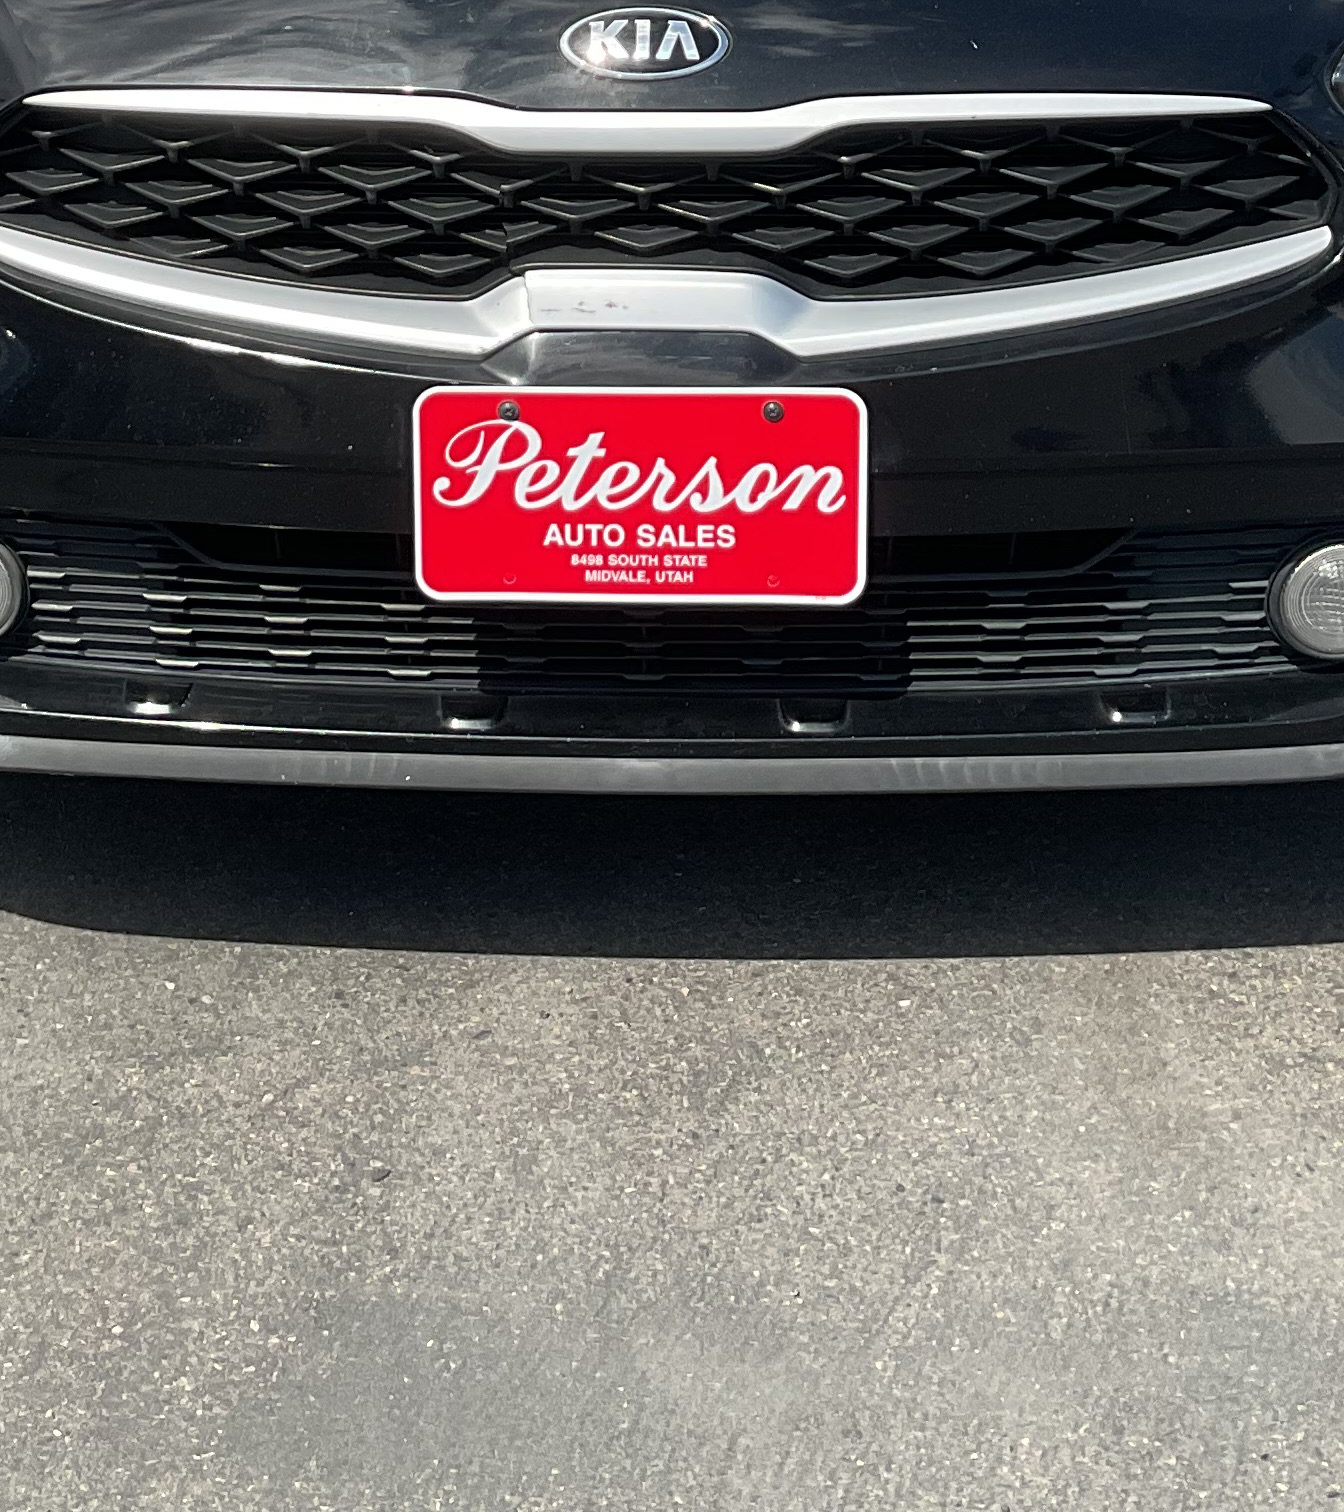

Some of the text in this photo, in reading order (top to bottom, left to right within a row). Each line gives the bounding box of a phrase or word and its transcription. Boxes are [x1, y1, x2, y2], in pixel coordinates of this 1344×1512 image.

[589, 19, 700, 62] KIA
[432, 419, 847, 514] Peterson
[543, 523, 737, 549] AUTO SALES
[571, 553, 708, 567] 8498 SOUTH STATE
[585, 569, 694, 584] MIDVALE, UTAH
